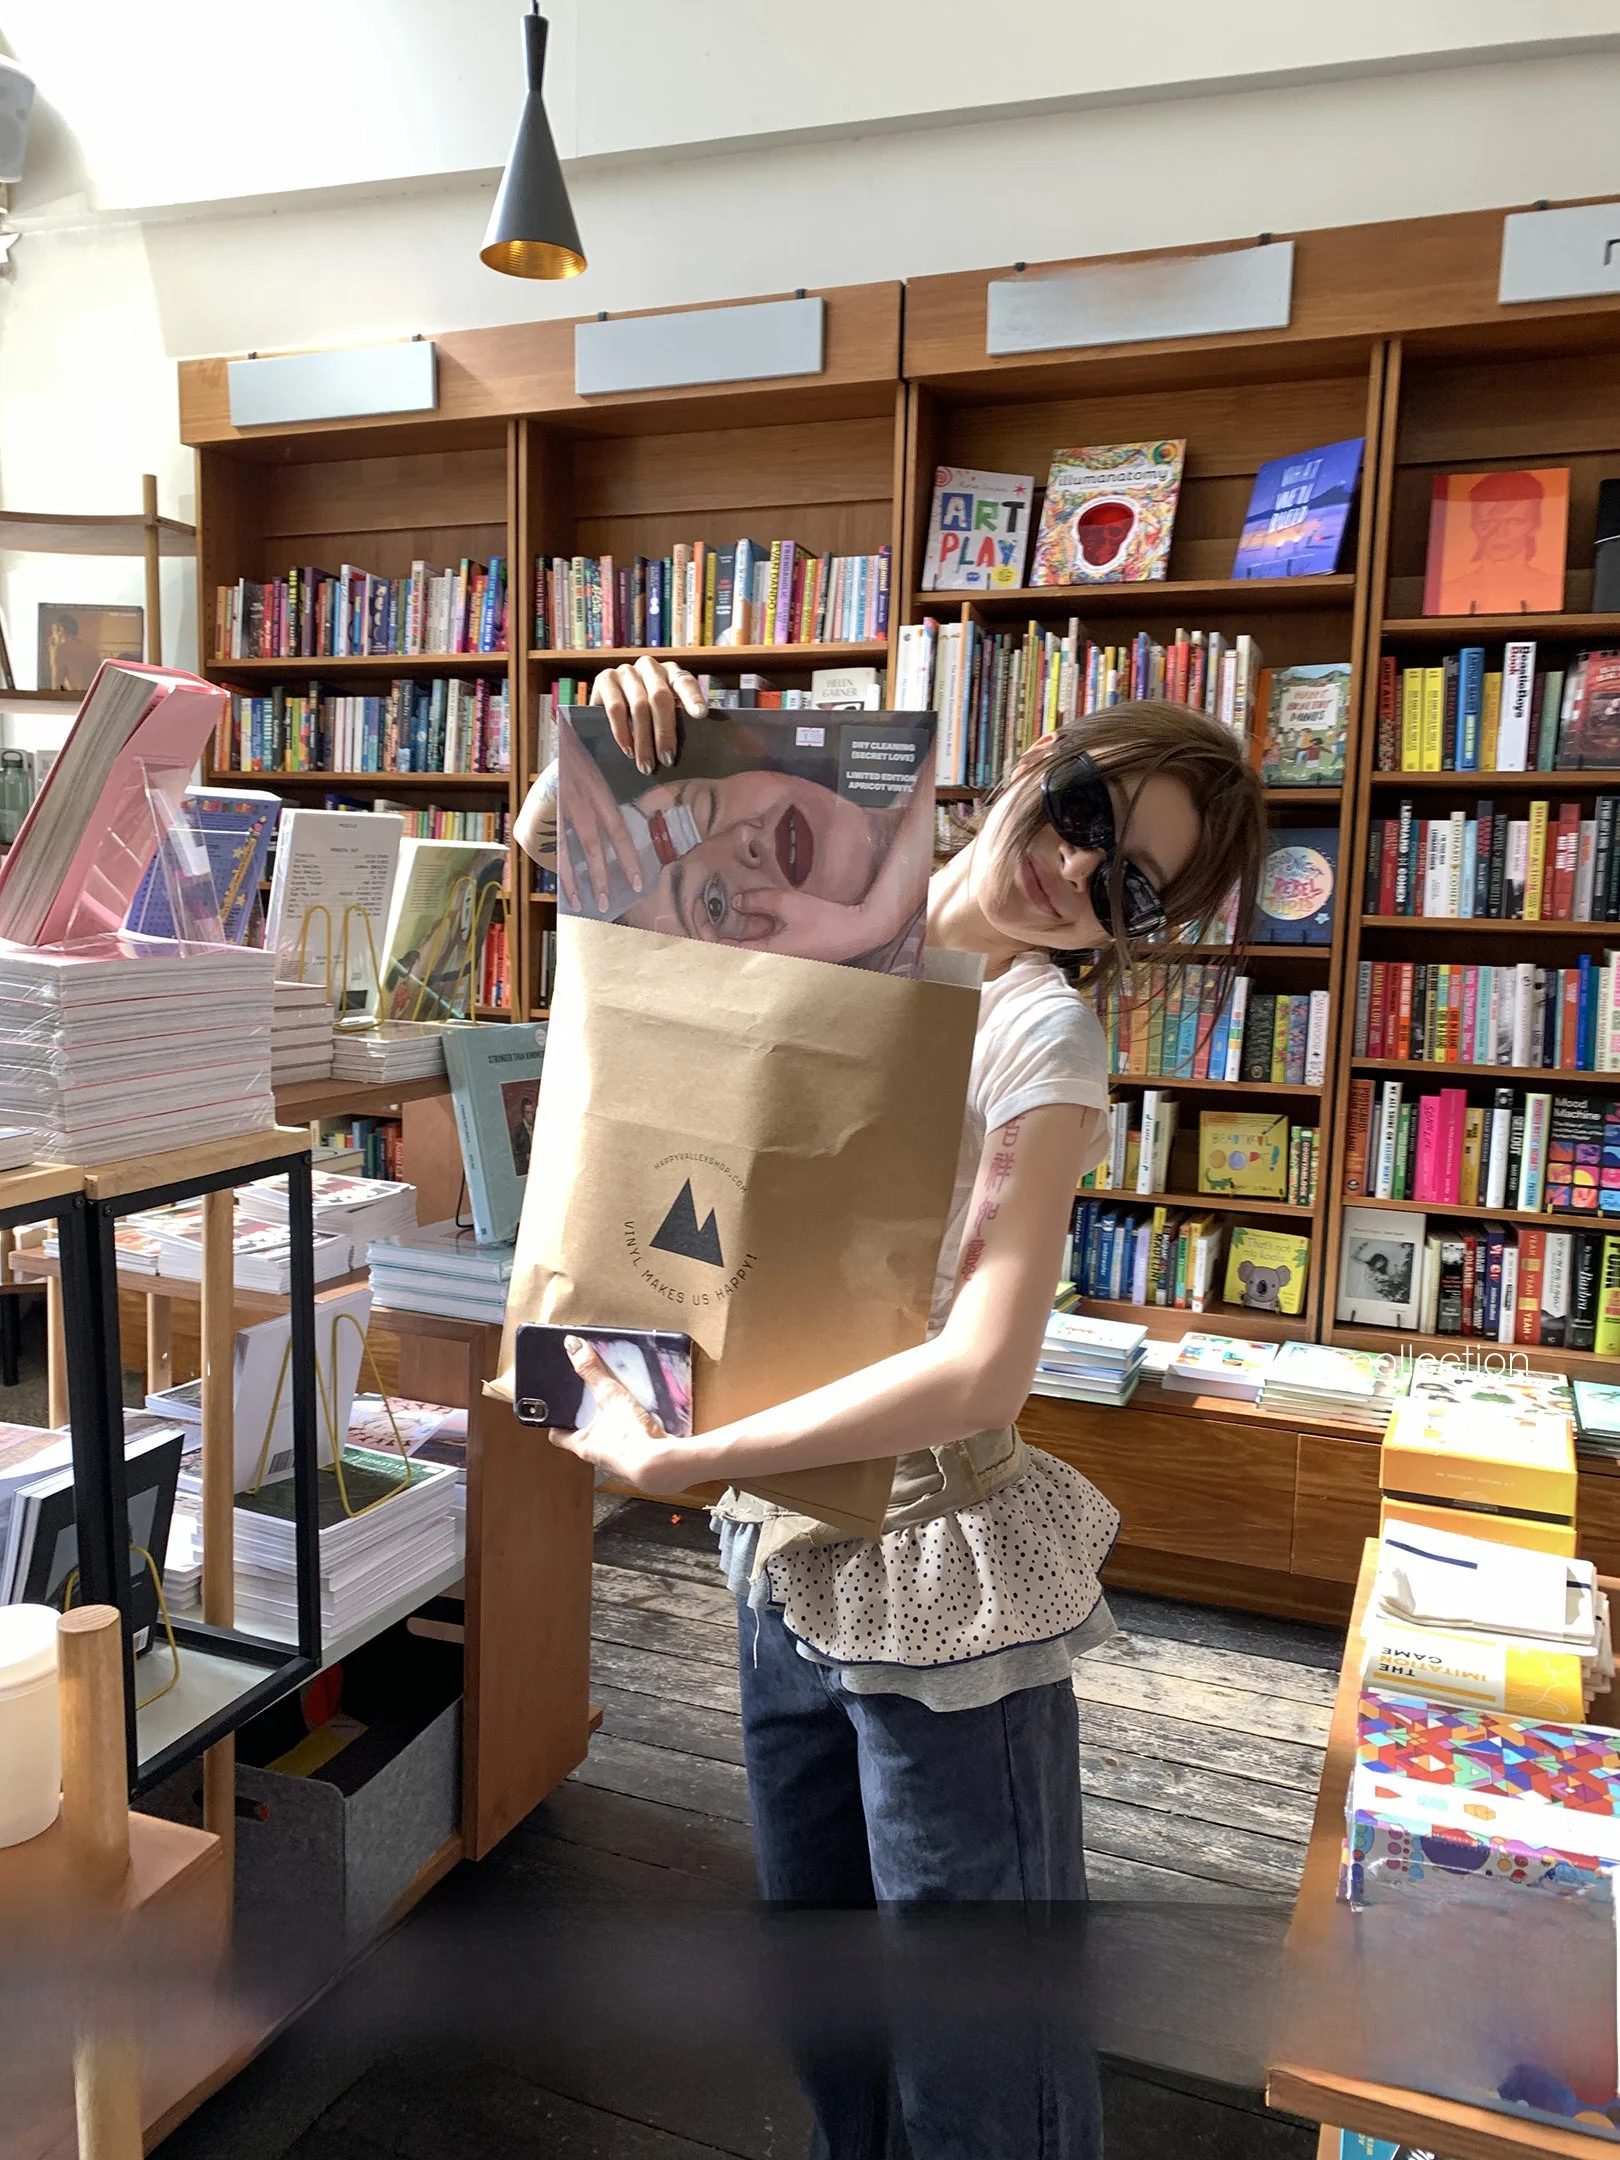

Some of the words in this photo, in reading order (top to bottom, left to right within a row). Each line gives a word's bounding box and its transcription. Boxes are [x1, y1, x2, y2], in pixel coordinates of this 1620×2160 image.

[1058, 469, 1169, 486] illumanatomy
[942, 495, 1025, 533] ART
[770, 543, 780, 570] EVAN
[940, 532, 1017, 568] PLAY
[781, 544, 791, 599] FRIENDAHOLIC
[878, 558, 888, 591] untamed
[768, 572, 778, 609] DANDO
[1508, 646, 1520, 676] Book
[822, 688, 858, 697] GARNER
[827, 679, 853, 688] HELEN
[851, 751, 887, 760] (SECRET
[888, 752, 915, 762] LOVE)
[852, 741, 870, 749] DRY
[870, 742, 916, 752] CLEANING
[845, 771, 881, 780] LIMITED
[881, 773, 917, 783] EDITION
[848, 782, 885, 791] APRICOT
[887, 783, 914, 793] VINYL
[1400, 805, 1412, 854] LEONARD
[1534, 806, 1544, 836] SHAKE
[1430, 829, 1438, 852] LEONARD
[1452, 820, 1461, 862] LEONARD
[1417, 842, 1426, 874] COHEN
[1396, 868, 1406, 902] COHEN
[1528, 857, 1538, 891] ACTION
[1449, 874, 1458, 906] COHEN
[1360, 964, 1369, 1000] GRANT
[1372, 965, 1383, 994] REMAIN
[1372, 997, 1381, 1005] IN
[1312, 999, 1326, 1051] WILDWOOD
[1371, 1008, 1381, 1027] LOVE
[1391, 1086, 1398, 1095] WE
[1554, 1097, 1589, 1109] Mood
[1358, 1087, 1371, 1133] POSTCARDS
[1387, 1111, 1396, 1128] SHINE
[1424, 1105, 1434, 1131] SONIC
[1553, 1107, 1602, 1121] Machine
[1387, 1132, 1393, 1140] ON
[1510, 1116, 1524, 1156] SELLOUT
[653, 1152, 748, 1194] HAPPYVALLEYSHOP.COM
[1528, 1234, 1538, 1256] YEAH
[623, 1220, 643, 1267] VINYL
[641, 1269, 684, 1304] MAKES
[692, 1293, 710, 1306] US
[714, 1253, 758, 1300] HAPPY!
[1463, 1250, 1474, 1289] SOLANGE
[1525, 1274, 1534, 1295] YEAH
[1577, 1271, 1593, 1310] Barbra
[1523, 1312, 1533, 1334] YEAH
[1378, 1663, 1416, 1677] THE
[1379, 1654, 1487, 1682] IMITATION
